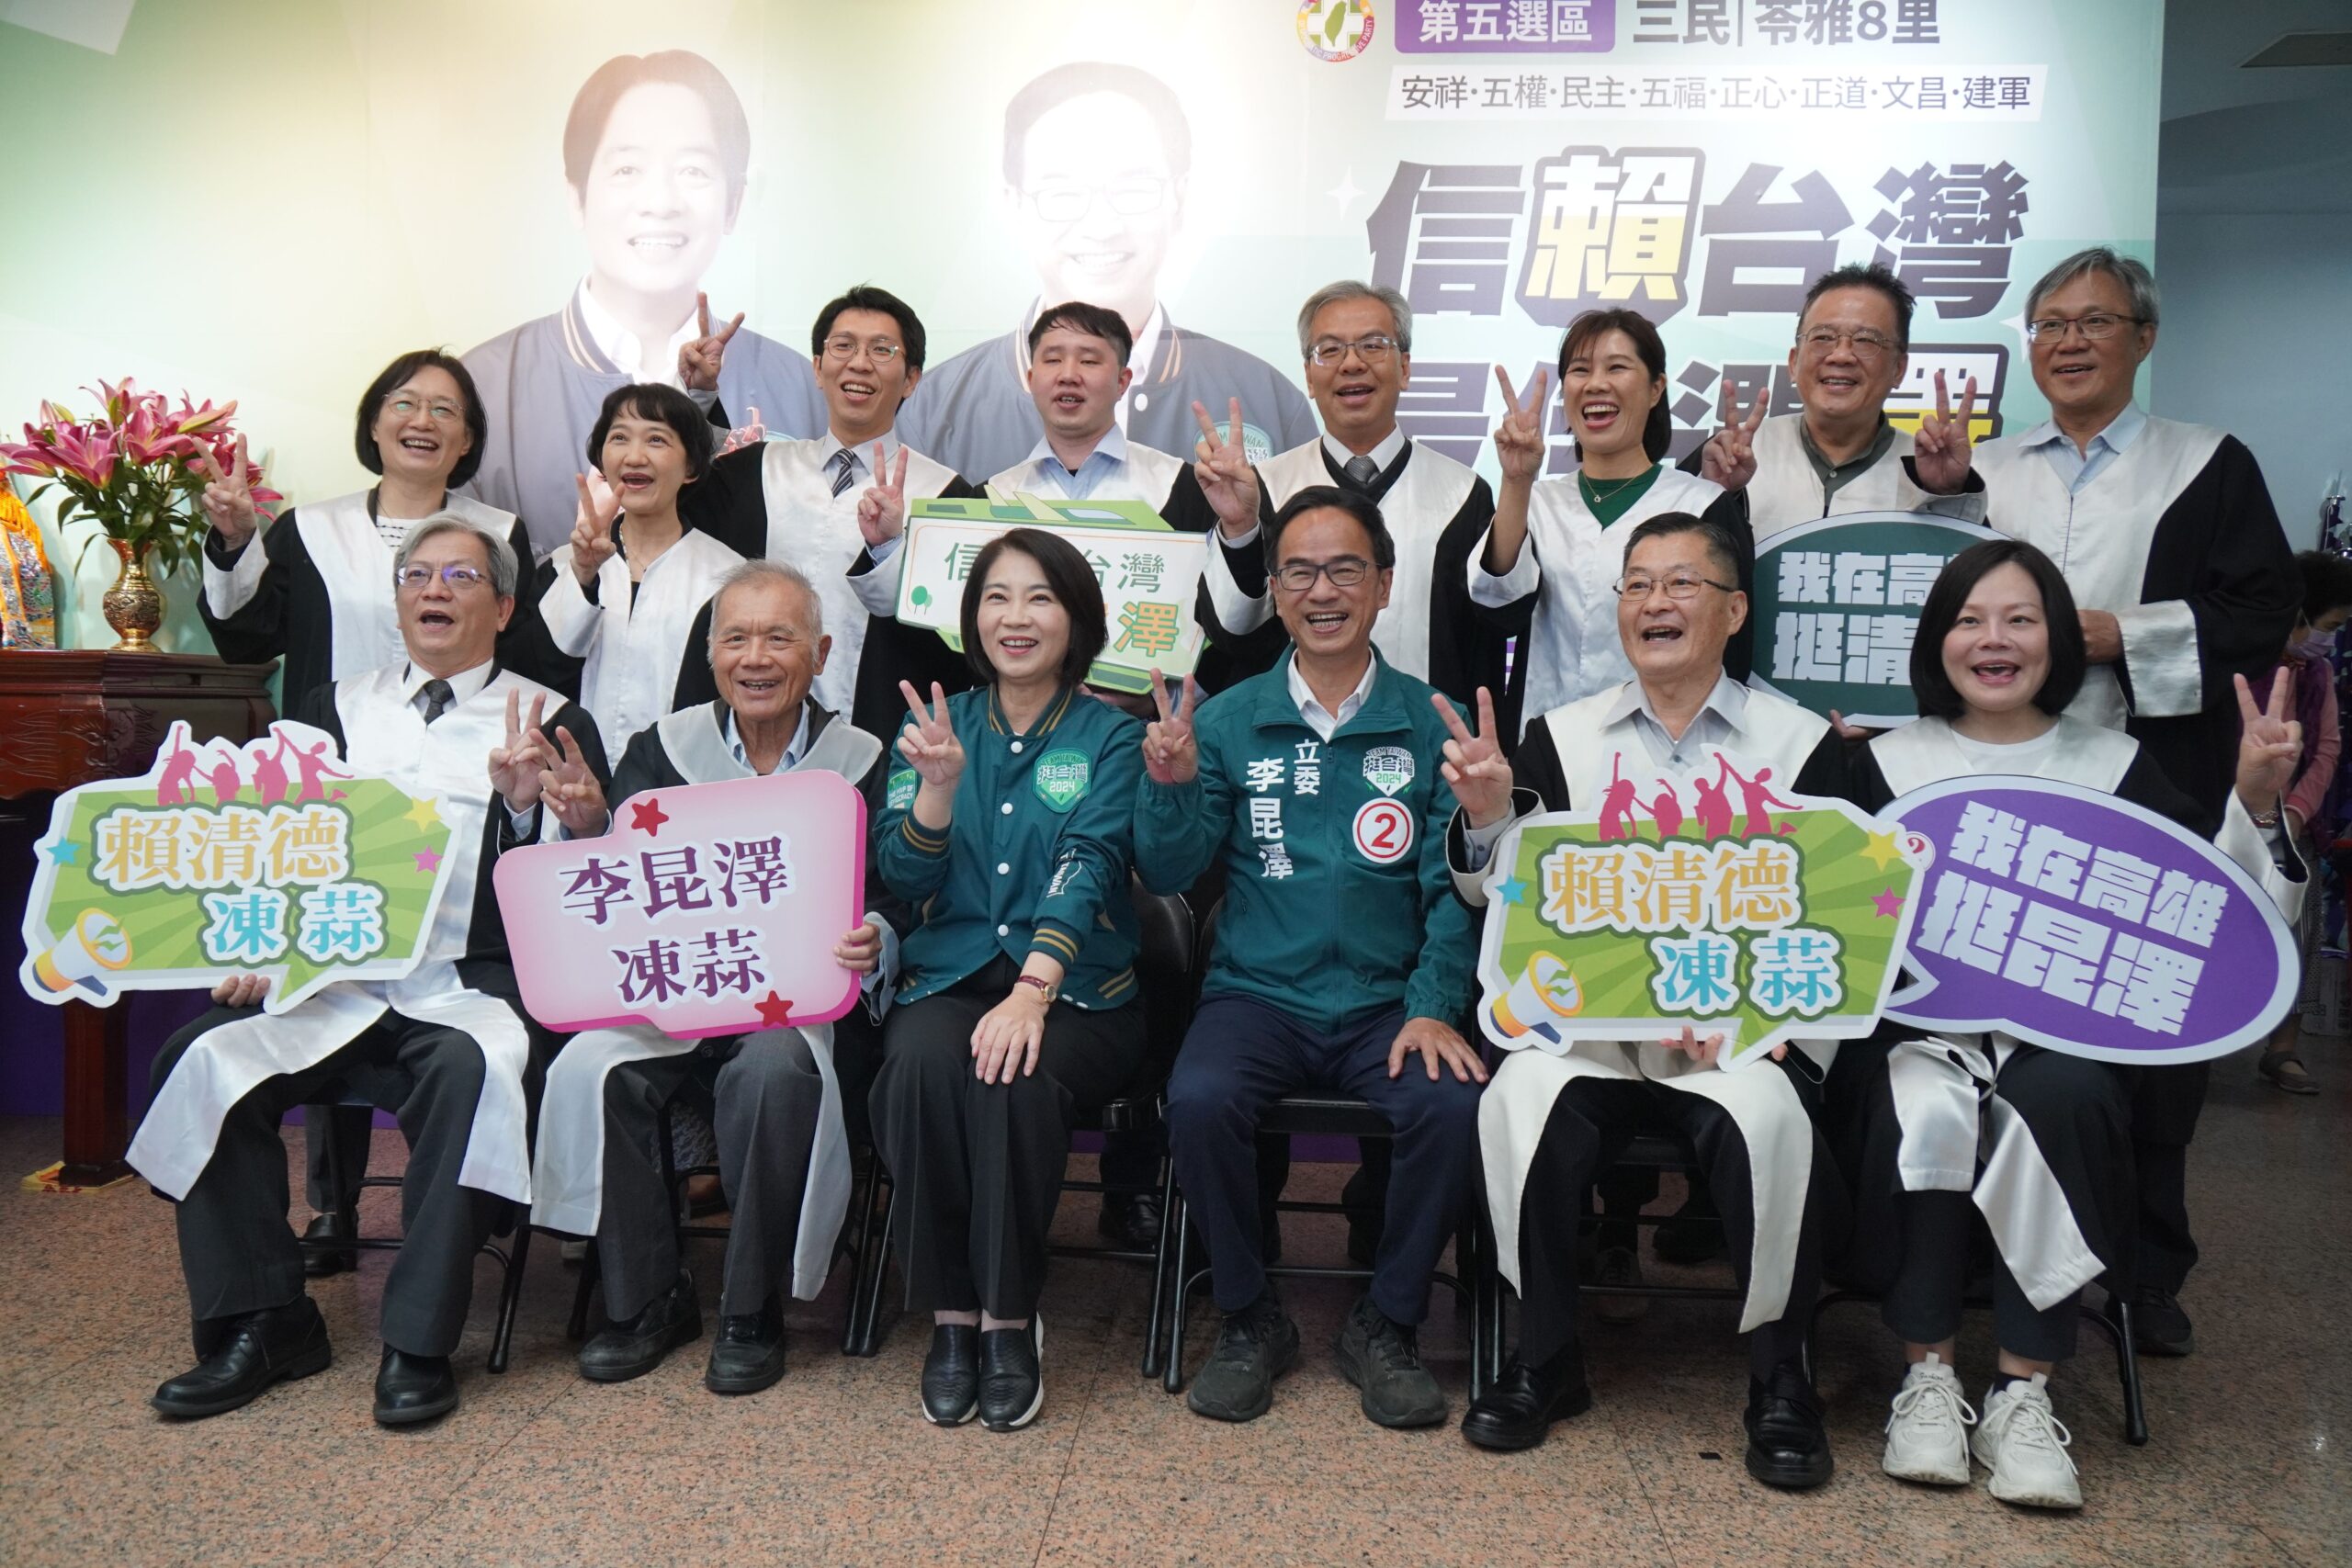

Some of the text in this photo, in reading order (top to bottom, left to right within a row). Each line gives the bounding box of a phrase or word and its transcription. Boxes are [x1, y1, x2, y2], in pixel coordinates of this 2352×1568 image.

[1419, 0, 1593, 43] 第五選區
[1365, 149, 2029, 321] 信賴台灣
[1778, 551, 1959, 606] 我在高
[1049, 781, 1075, 793] 2024
[1294, 739, 1320, 795] 立委
[1375, 773, 1402, 784] 2024
[102, 811, 342, 884] 賴清德
[1246, 758, 1294, 879] 李昆澤
[1371, 813, 1396, 849] 2
[559, 836, 788, 926] 李昆澤
[1548, 847, 1792, 926] 賴清德
[1948, 800, 2230, 949] 我在高雄
[210, 889, 376, 956] 凍蒜
[1915, 869, 2205, 1037] 挺昆澤
[611, 929, 766, 1004] 凍蒜
[1658, 936, 1835, 1009] 凍蒜
